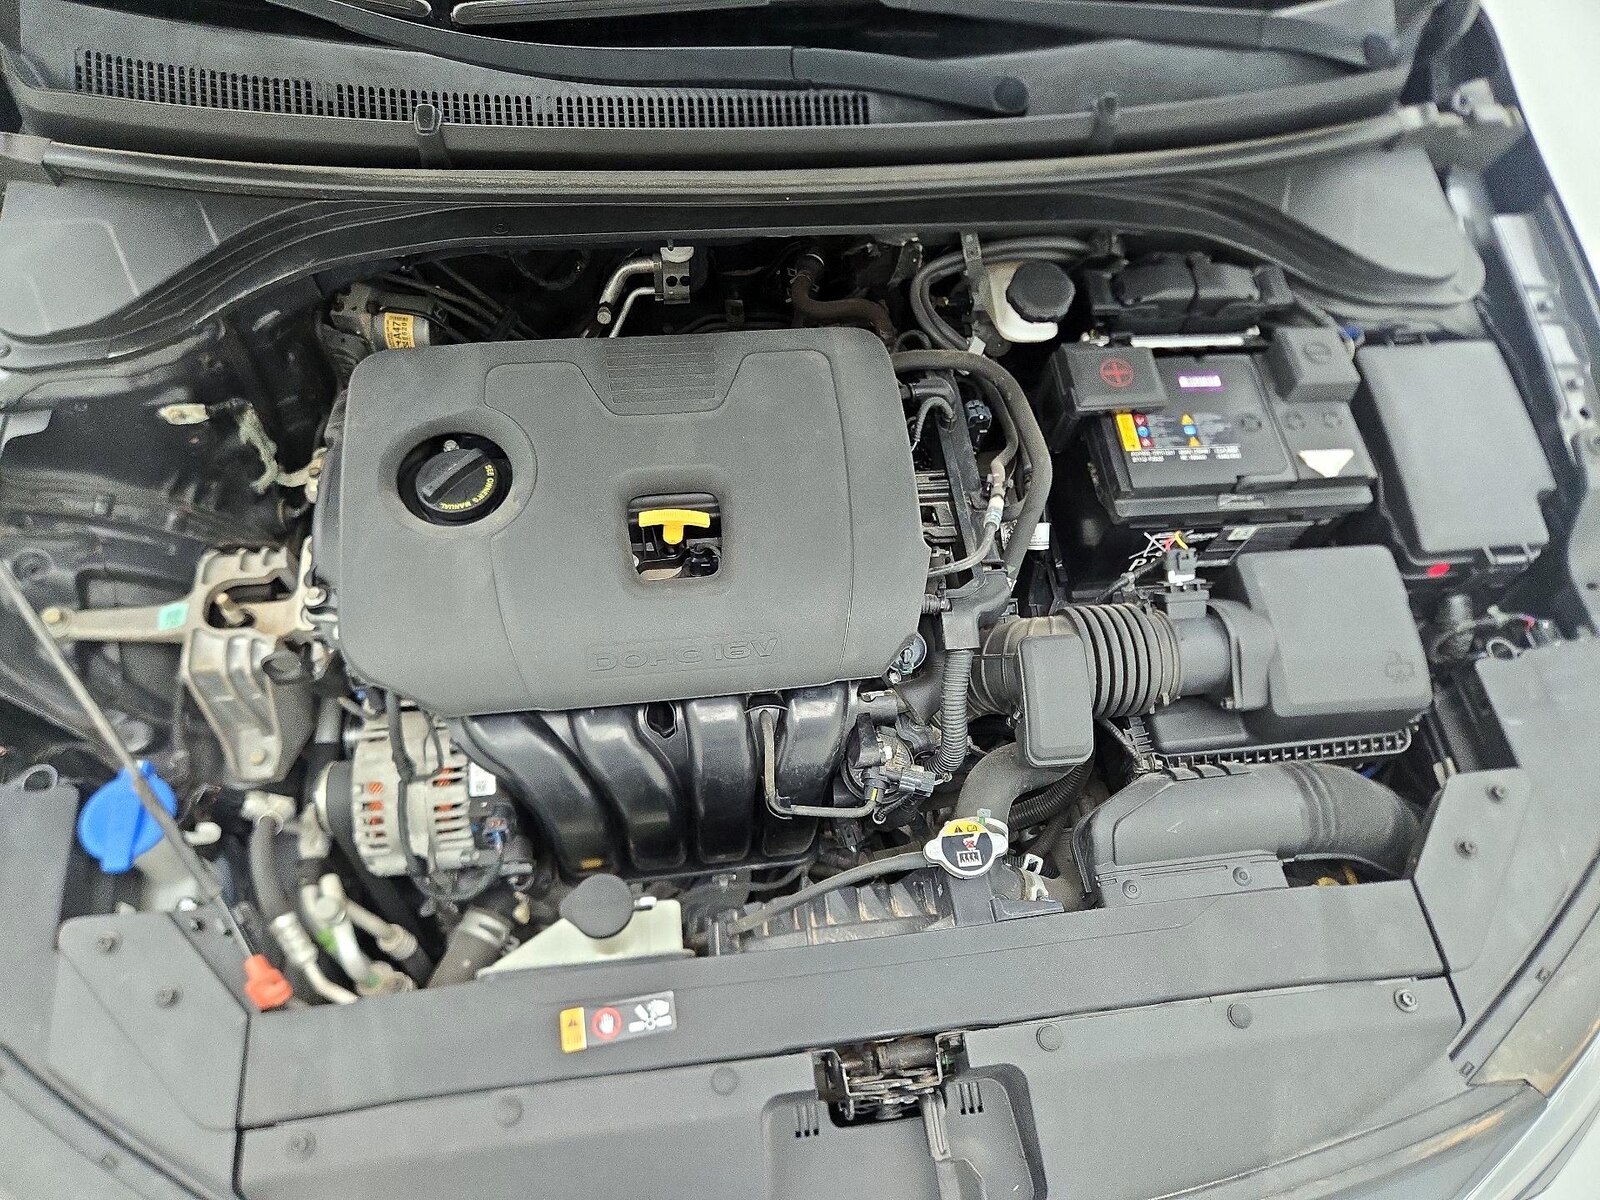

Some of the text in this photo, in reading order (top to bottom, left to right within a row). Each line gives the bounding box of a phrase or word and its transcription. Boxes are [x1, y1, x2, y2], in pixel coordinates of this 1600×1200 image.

[440, 464, 495, 510] SEE OWNER'S MANUAL
[588, 638, 778, 672] DOHC 16V
